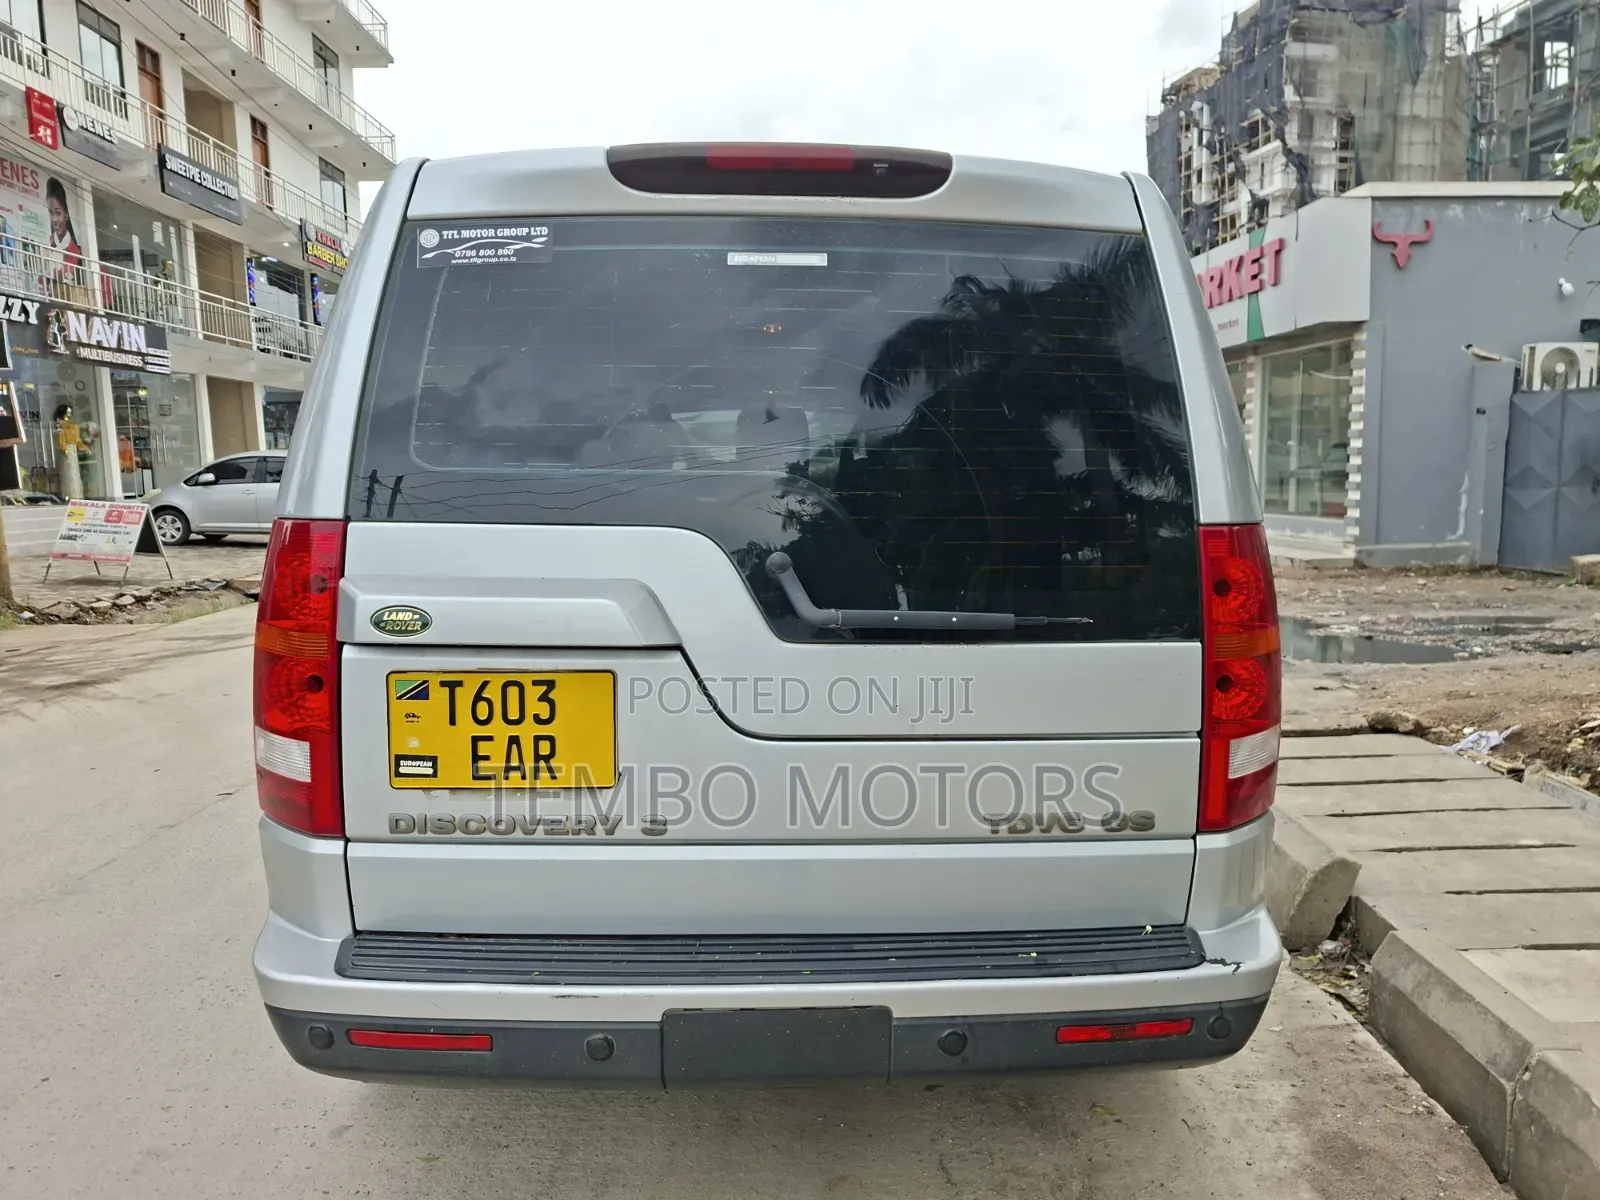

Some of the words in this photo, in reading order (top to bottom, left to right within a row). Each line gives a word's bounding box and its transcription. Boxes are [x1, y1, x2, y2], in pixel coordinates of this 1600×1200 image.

[76, 111, 118, 144] NENES
[165, 153, 200, 183] SWEETPIE
[200, 170, 238, 200] COLLECTION
[442, 230, 459, 239] TFL
[461, 228, 495, 238] MOTOR
[497, 227, 529, 237] GROUP
[531, 226, 548, 236] LTD
[307, 241, 335, 266] BARBER
[455, 249, 476, 257] 0786
[498, 248, 514, 256] 890
[1197, 237, 1284, 309] RKET
[67, 310, 148, 353] NAVIN
[79, 348, 144, 367] MULTIBUSINESS
[70, 500, 106, 509] WAKALA
[385, 621, 422, 631] ROVER
[439, 679, 556, 727] T603
[400, 760, 433, 769] EUROPEAN
[471, 734, 558, 781] EAR
[388, 812, 623, 837] DISCOVERY
[640, 813, 669, 837] 3
